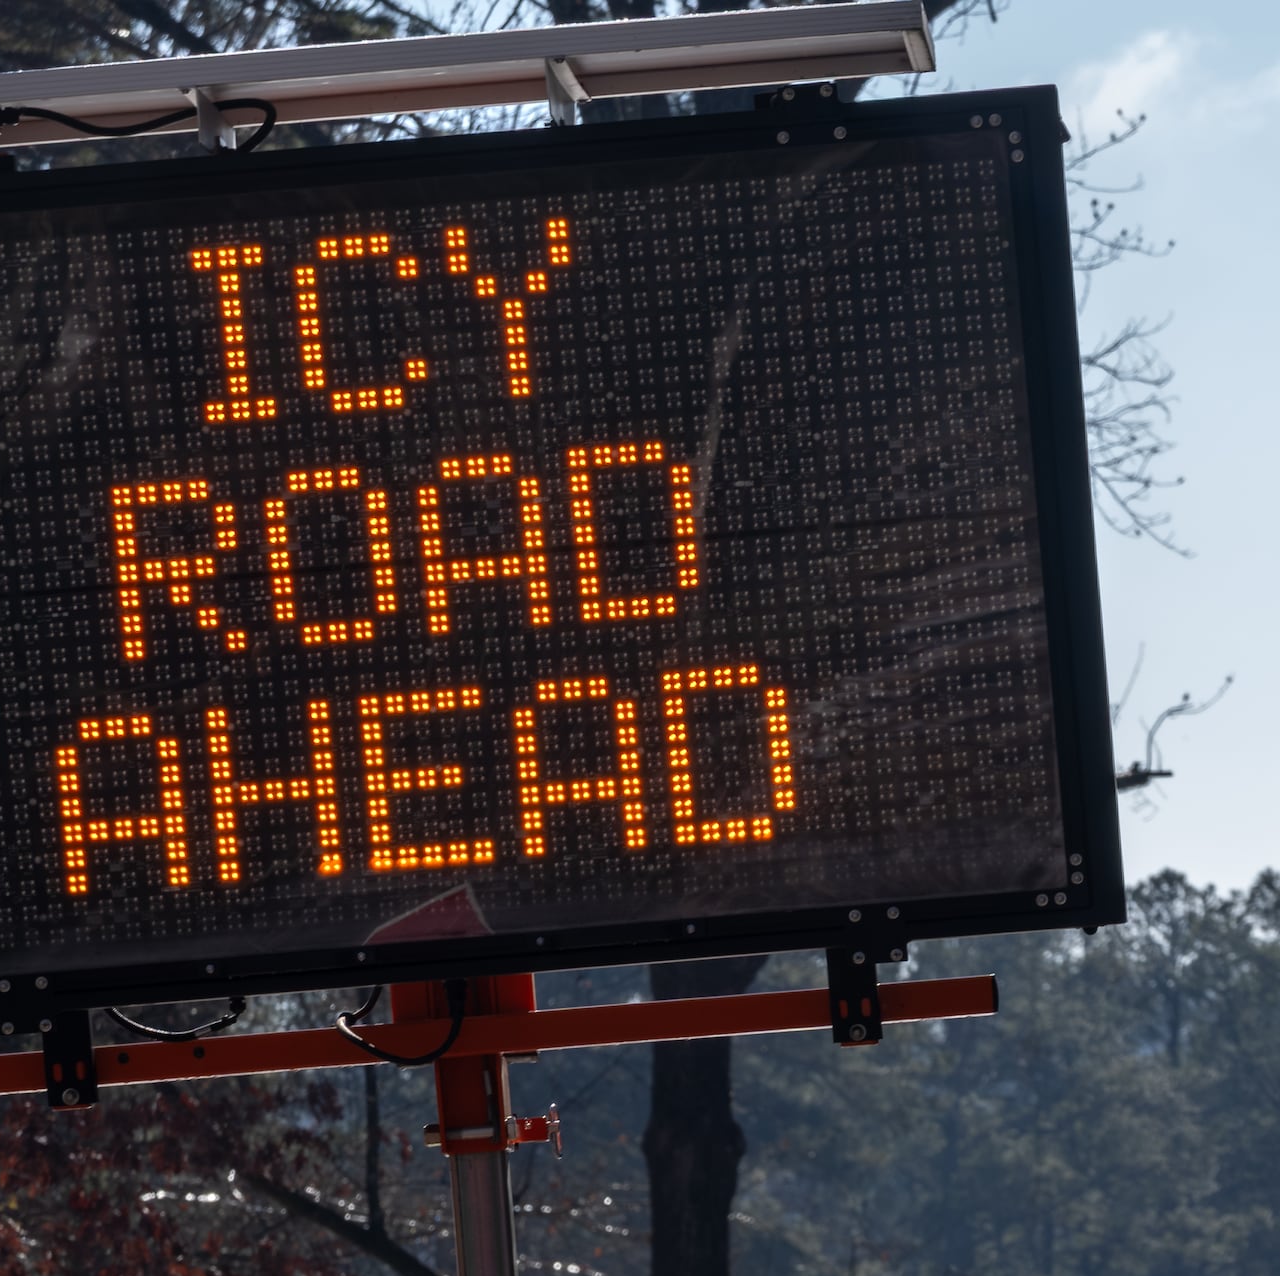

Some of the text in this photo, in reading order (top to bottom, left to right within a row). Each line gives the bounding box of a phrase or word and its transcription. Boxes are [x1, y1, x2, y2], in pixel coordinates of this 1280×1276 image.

[191, 218, 570, 422] ICY
[111, 441, 698, 660] ROAD
[54, 664, 795, 894] AHEAD
